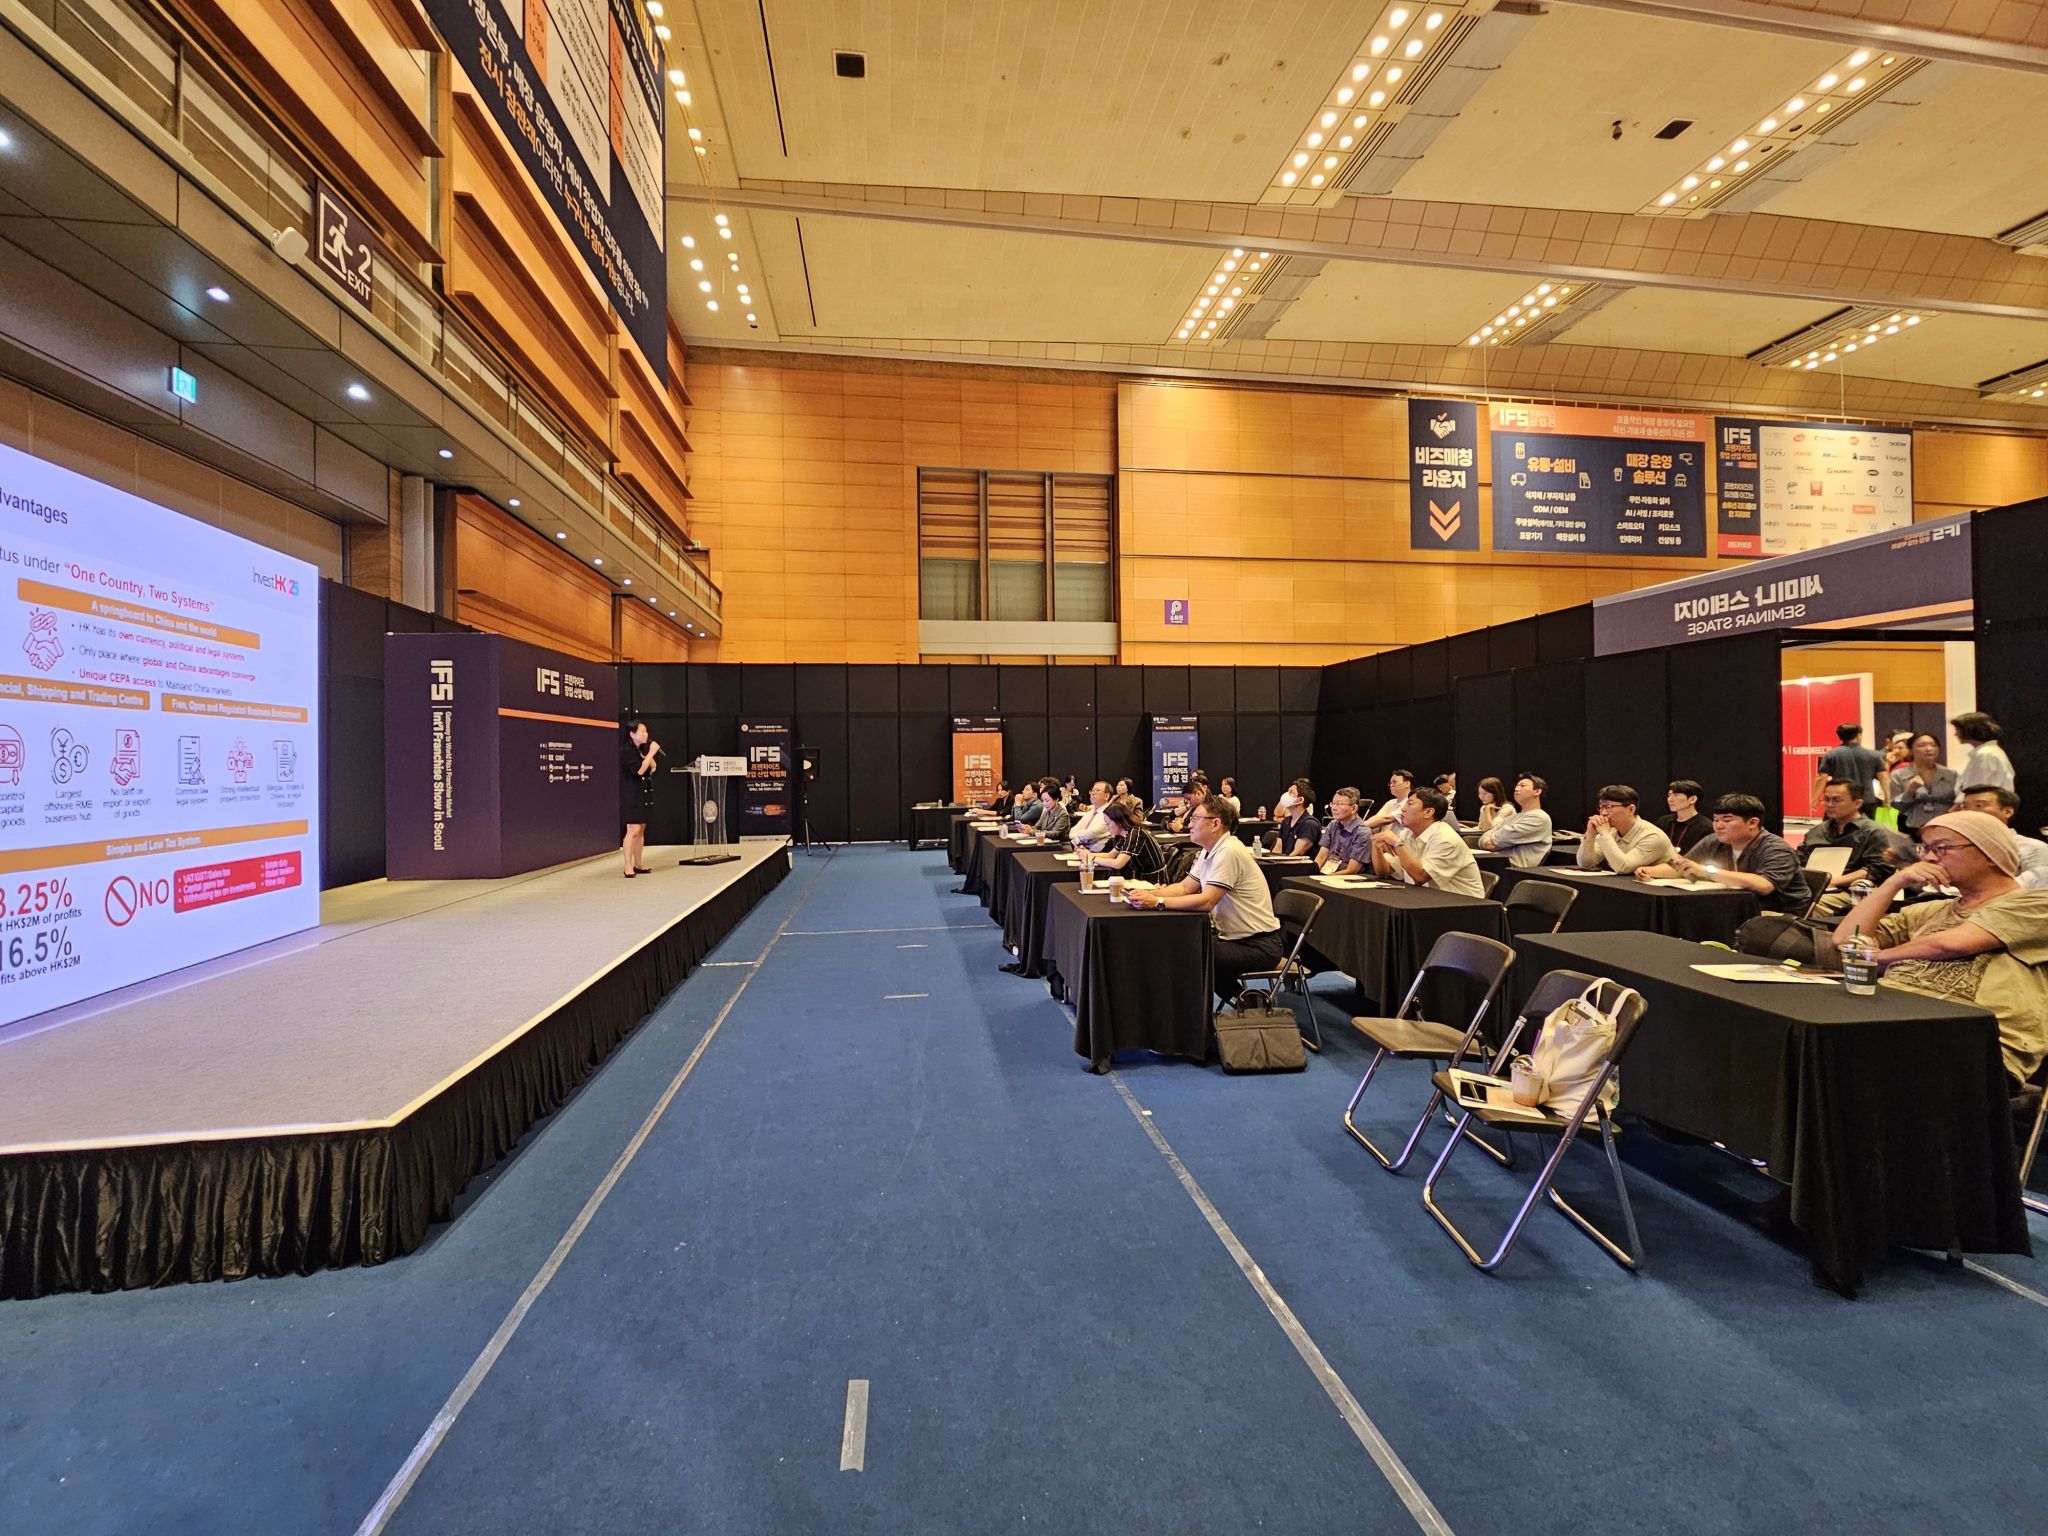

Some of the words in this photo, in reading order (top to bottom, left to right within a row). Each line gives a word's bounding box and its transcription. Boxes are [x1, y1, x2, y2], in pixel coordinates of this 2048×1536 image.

[479, 37, 503, 97] 전시
[506, 83, 563, 196] 참관객이라면
[591, 229, 605, 266] 참여
[514, 60, 534, 112] 매장
[535, 102, 565, 171] 운영자,
[566, 156, 582, 199] 예비
[583, 185, 604, 237] 창업자
[358, 244, 371, 282] 2
[347, 270, 371, 300] EXIT
[1500, 409, 1529, 427] IFS
[1724, 427, 1751, 444] IFS
[1415, 446, 1473, 467] 비즈매칭
[1626, 453, 1649, 468] 매장
[1650, 454, 1672, 469] 운영
[1423, 469, 1466, 488] 라운지
[1633, 469, 1666, 485] 솔루션
[1533, 505, 1549, 513] ODM
[1637, 509, 1647, 517] 서빙
[1616, 522, 1645, 530] 스마트오더
[1659, 523, 1681, 531] 키오스크
[1619, 535, 1642, 544] 인테리어
[1658, 536, 1675, 544] 컨설팅
[23, 554, 60, 574] under
[100, 571, 146, 598] Country,
[149, 584, 168, 602] Two
[79, 623, 89, 632] HK
[119, 632, 134, 642] own
[169, 640, 193, 654] political
[195, 645, 206, 655] and
[208, 646, 221, 658] legal
[222, 650, 245, 662] systems
[79, 646, 96, 660] Only
[120, 652, 141, 664] where
[143, 656, 163, 669] global
[165, 659, 177, 669] and
[179, 661, 196, 673] China
[198, 664, 230, 678] advantages
[79, 668, 107, 681] Unique
[109, 672, 130, 684] CEPA
[132, 677, 156, 687] access
[431, 660, 453, 700] IFS
[536, 667, 559, 695] IFS
[70, 689, 86, 700] and
[433, 732, 444, 780] Franchise
[750, 746, 780, 762] IFS
[964, 754, 991, 769] IFS
[1163, 752, 1188, 766] IFS
[706, 761, 720, 772] IFS
[56, 790, 82, 800] Largest
[111, 788, 118, 796] No
[433, 782, 444, 810] Show
[44, 801, 73, 811] offshore
[76, 800, 93, 809] RMB
[0, 817, 26, 829] goods
[45, 814, 77, 824] business
[80, 812, 93, 821] hub
[434, 811, 444, 821] in
[434, 822, 444, 850] Seoul
[106, 844, 132, 856] Simple
[134, 842, 148, 852] and
[150, 840, 163, 850] Low
[165, 839, 176, 849] Tax
[140, 879, 169, 908] NO
[6, 915, 40, 931] HK$2M
[43, 912, 51, 924] of
[54, 908, 82, 925] profits
[19, 966, 47, 980] above
[50, 955, 81, 972] HK$2M
